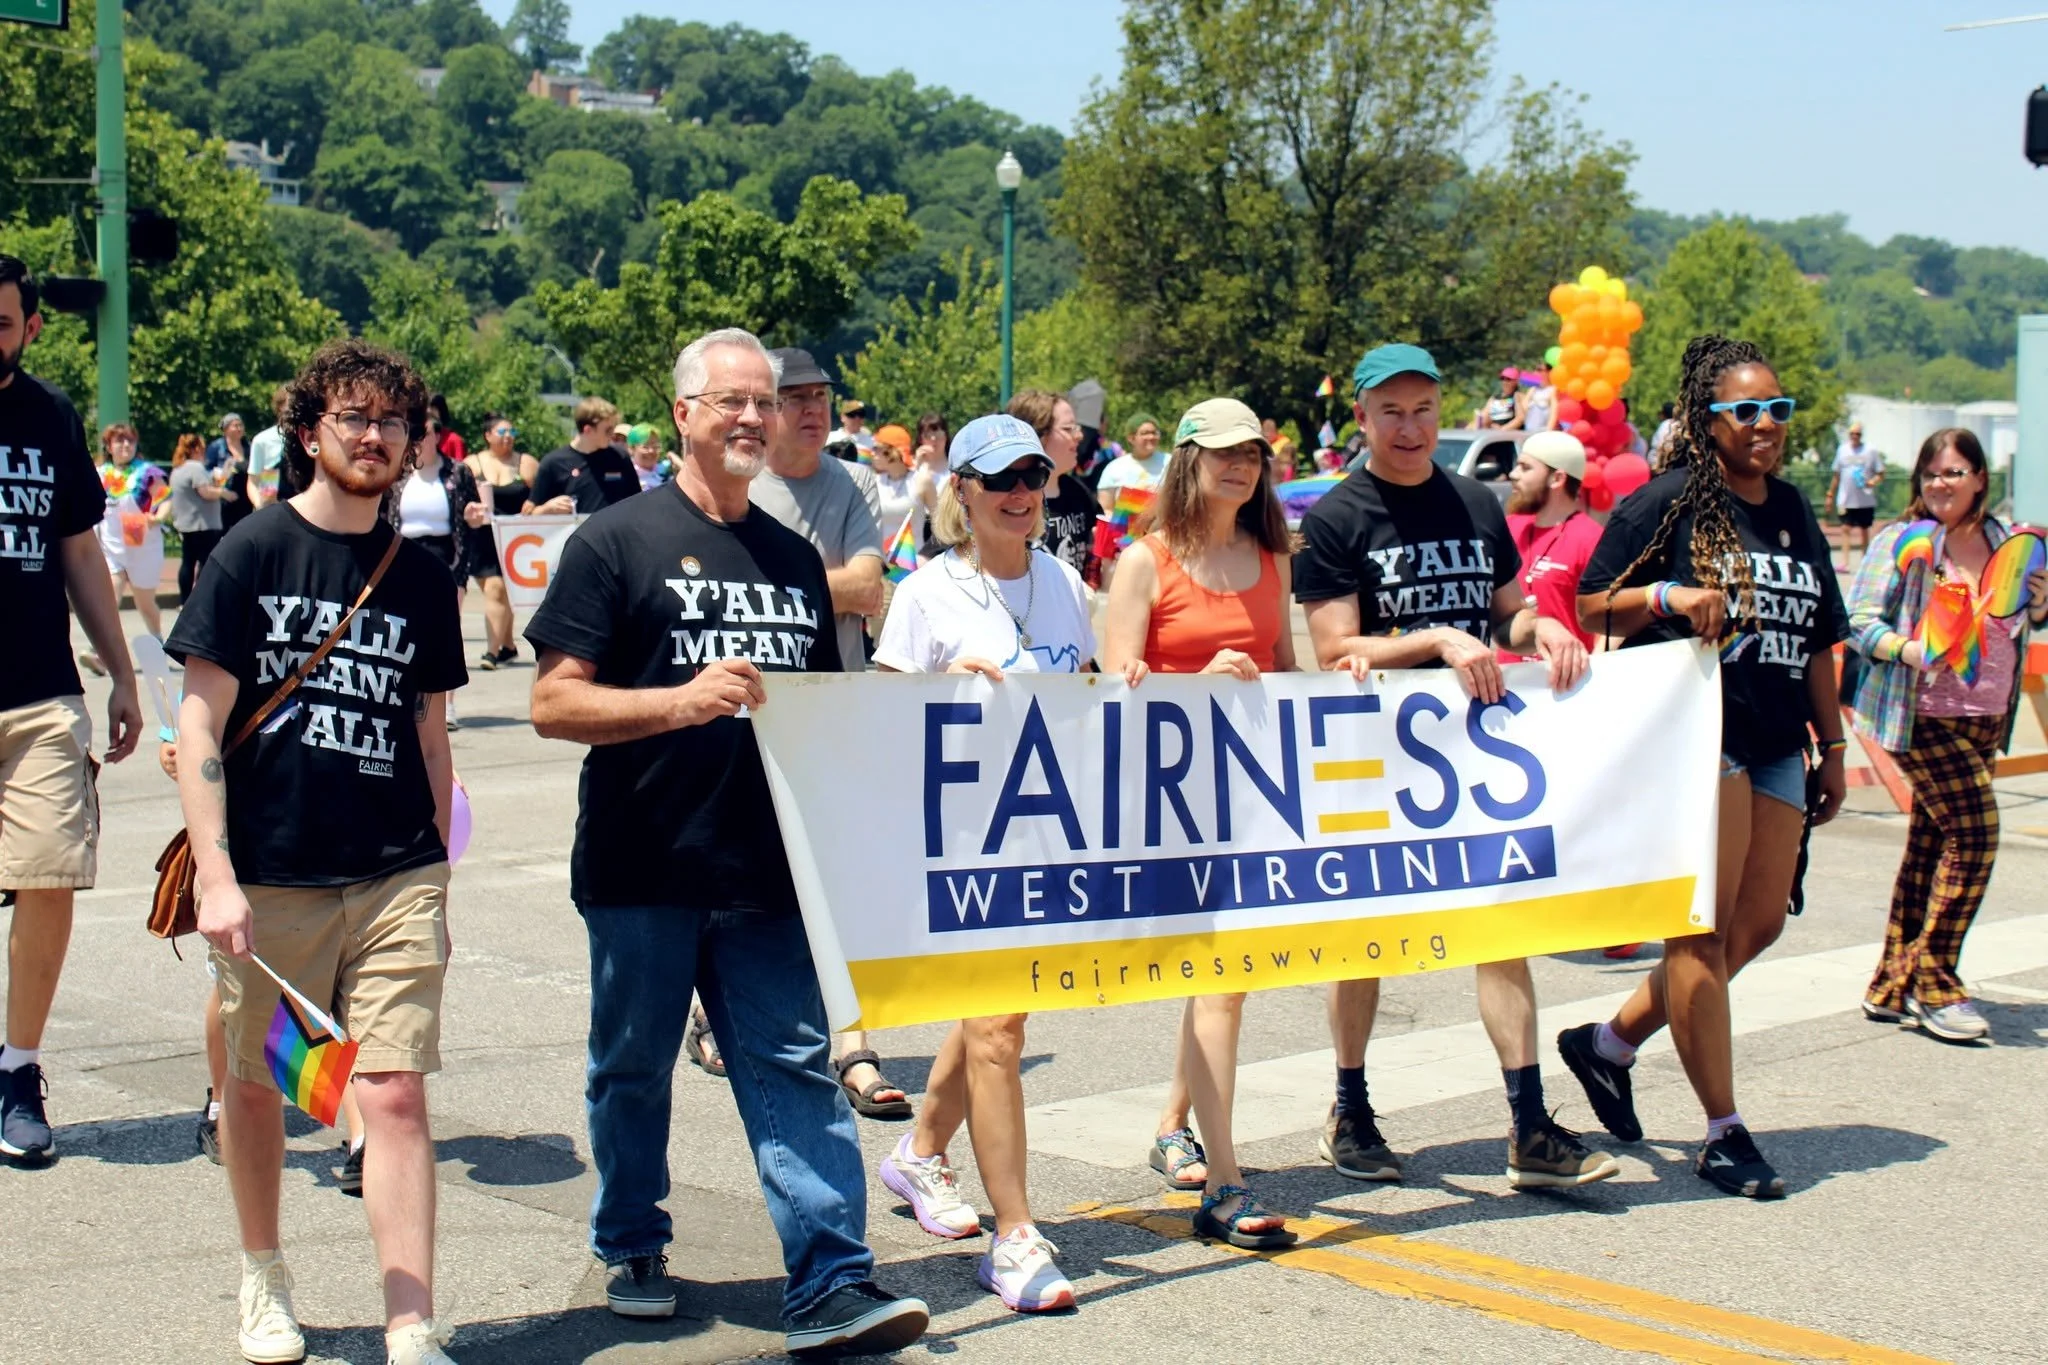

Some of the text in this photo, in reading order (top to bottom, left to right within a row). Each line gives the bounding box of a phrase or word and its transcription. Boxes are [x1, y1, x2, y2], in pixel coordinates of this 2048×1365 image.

[1367, 539, 1494, 585] Y'ALL
[258, 595, 415, 664] Y'ALL
[665, 578, 818, 630] Y'ALL
[301, 704, 396, 761] ALL
[924, 690, 1547, 858] FAIRNESS
[946, 835, 1535, 924] WEST VIRGINIA
[1032, 934, 1446, 993] fairnesswv.org
